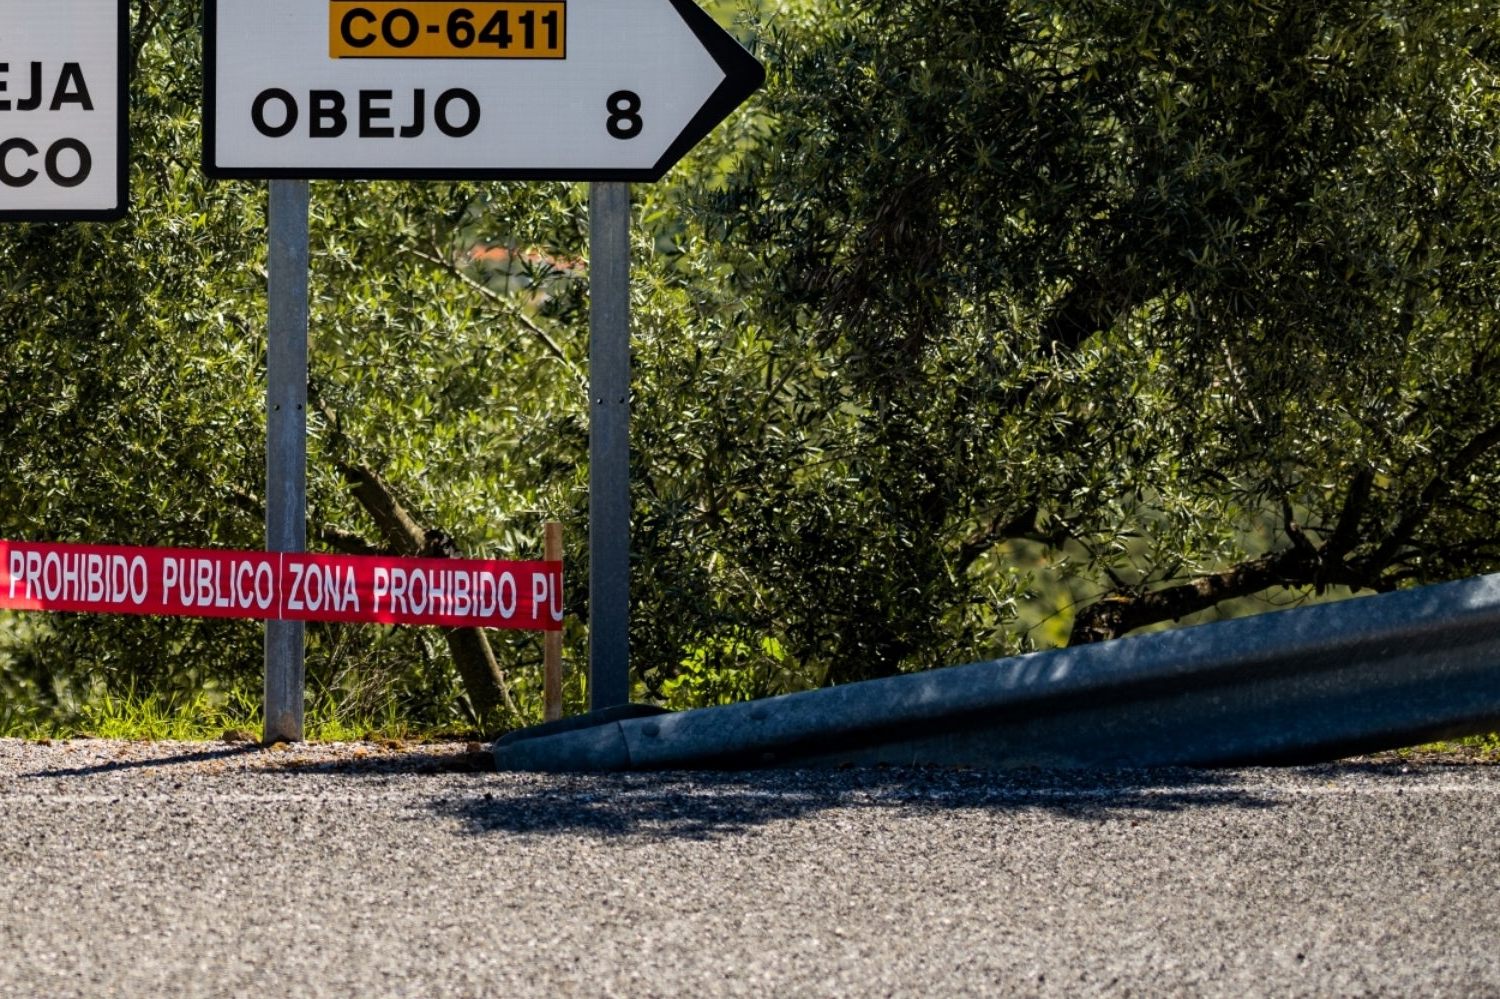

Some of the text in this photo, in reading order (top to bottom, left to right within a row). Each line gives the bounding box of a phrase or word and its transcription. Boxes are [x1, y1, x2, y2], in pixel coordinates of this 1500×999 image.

[340, 8, 558, 49] CO-6411
[251, 87, 643, 140] OBEJO 8
[10, 550, 147, 604] PROHIBIDO
[163, 557, 273, 609] PUBLICO
[288, 564, 360, 613] ZONA
[374, 568, 516, 619] PROHIBIDO
